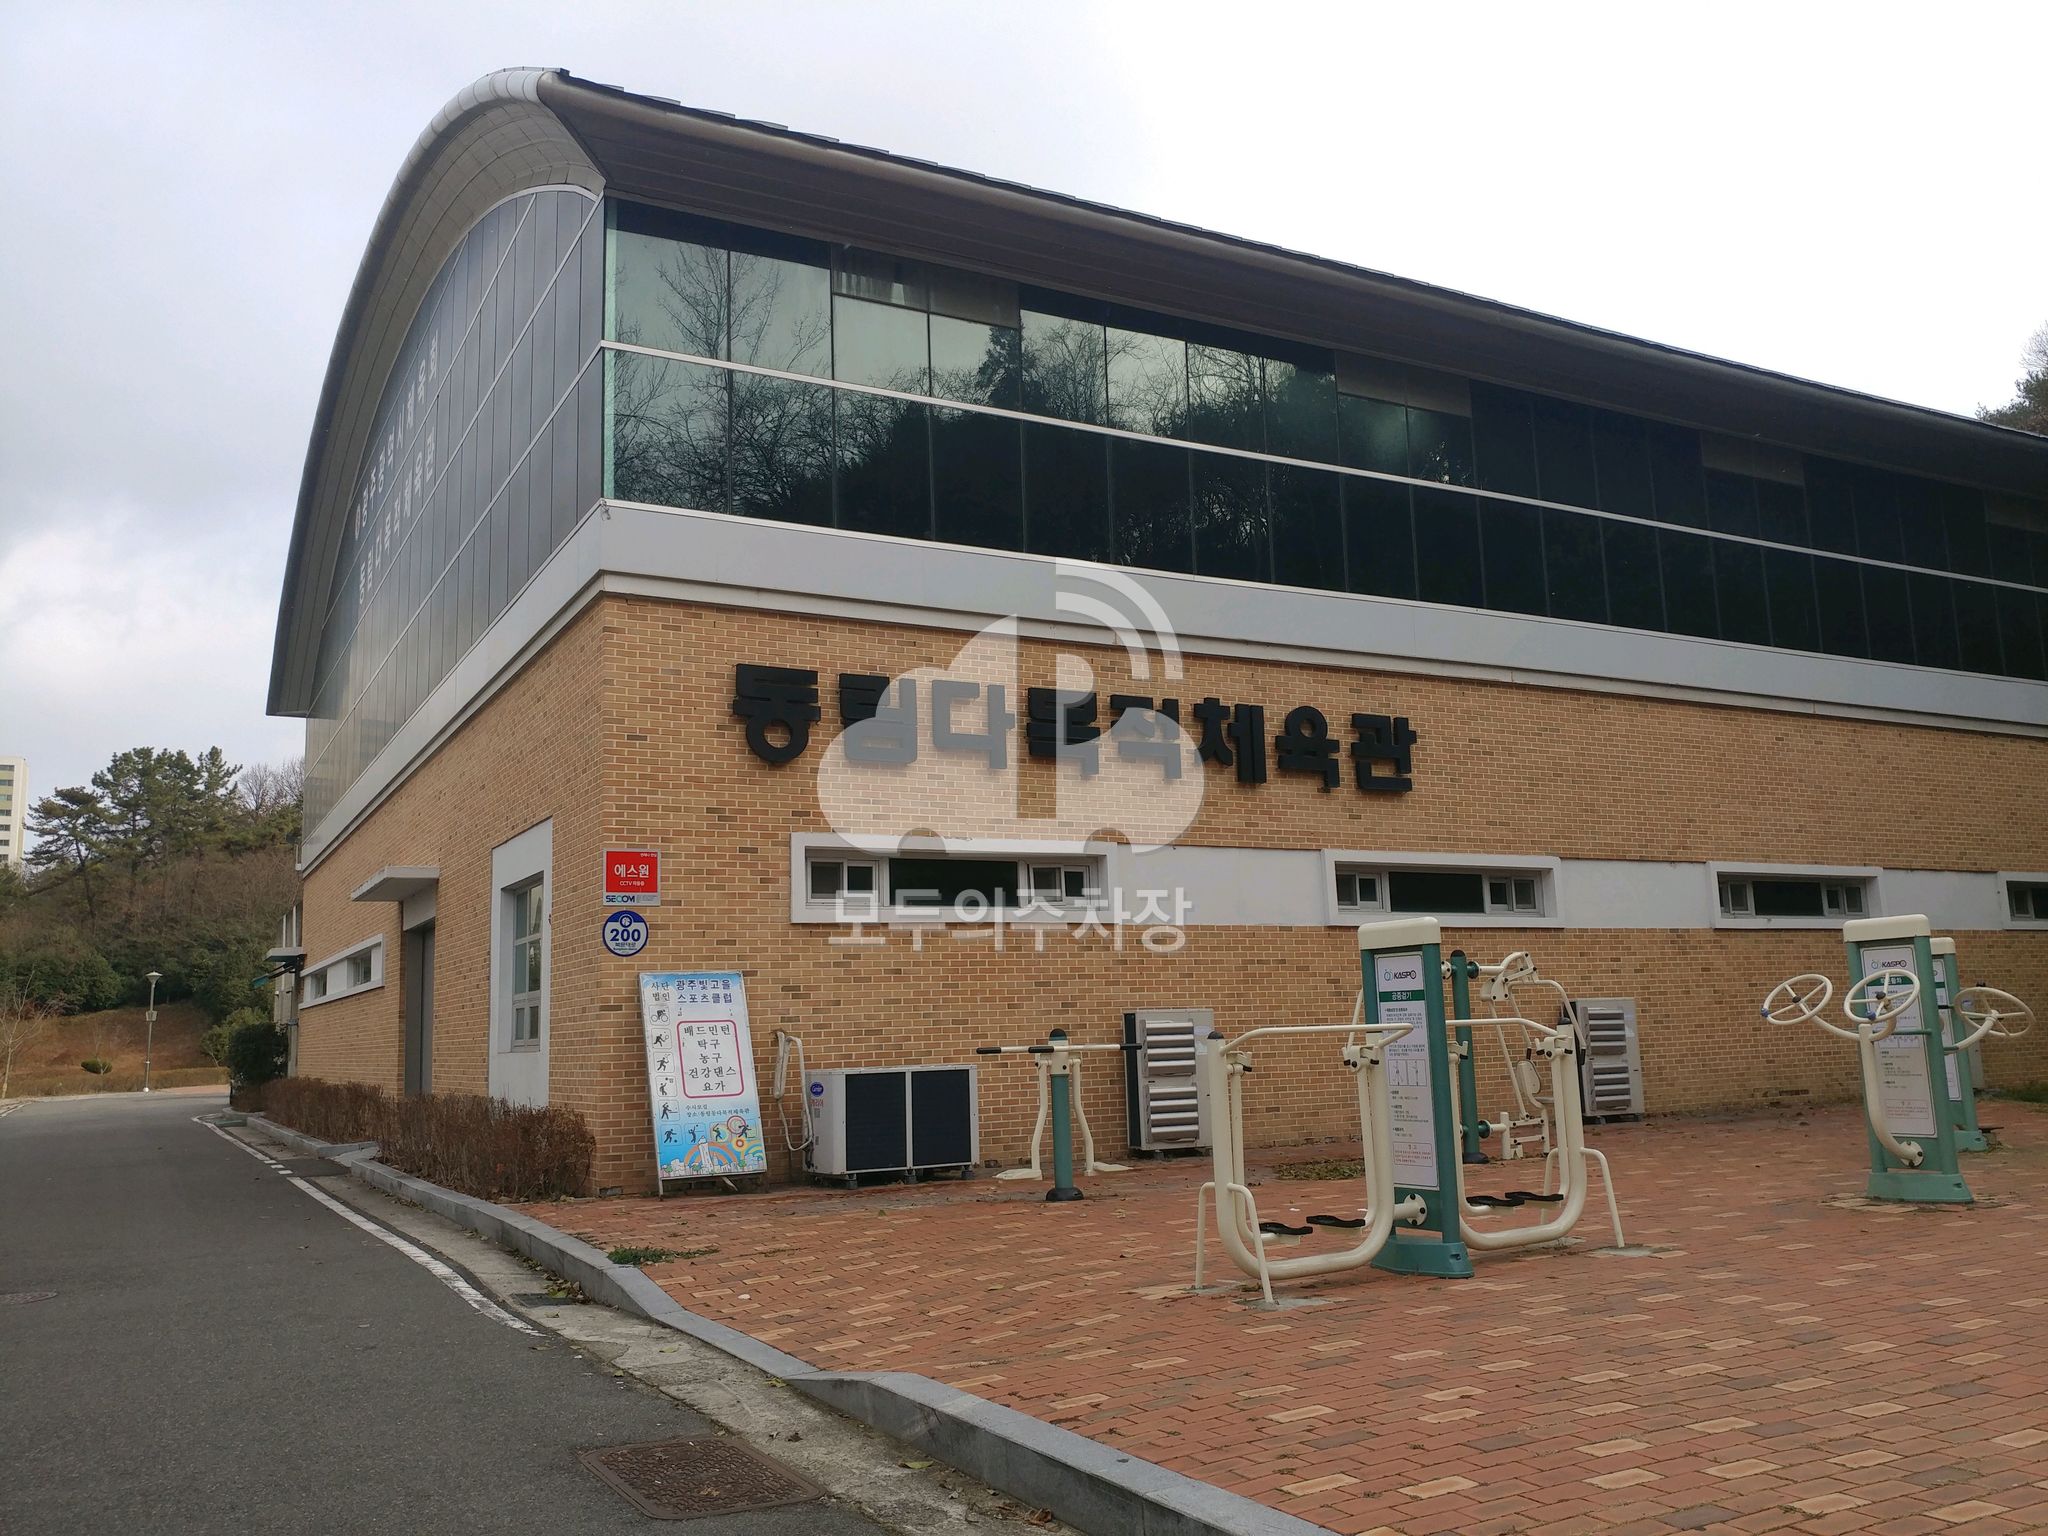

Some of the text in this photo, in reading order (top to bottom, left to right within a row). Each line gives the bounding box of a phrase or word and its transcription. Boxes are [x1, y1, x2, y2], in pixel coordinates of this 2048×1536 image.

[359, 426, 436, 605] 동림다목적체육관
[732, 663, 1418, 793] 동림다목적체육관
[614, 864, 649, 878] 에스원
[605, 895, 635, 903] SECOM
[610, 928, 641, 942] 200
[1882, 960, 1907, 968] KASPO
[1394, 970, 1417, 980] KASPO
[651, 981, 670, 991] 사단
[676, 979, 731, 991] 광주빛고을
[652, 992, 670, 1002] 법인
[677, 993, 732, 1004] 스포츠클럽
[684, 1025, 731, 1036] 배드민턴
[697, 1039, 720, 1050] 탁구
[699, 1053, 722, 1064] 농구
[689, 1066, 737, 1078] 건강댄스
[703, 1080, 726, 1091] 요가
